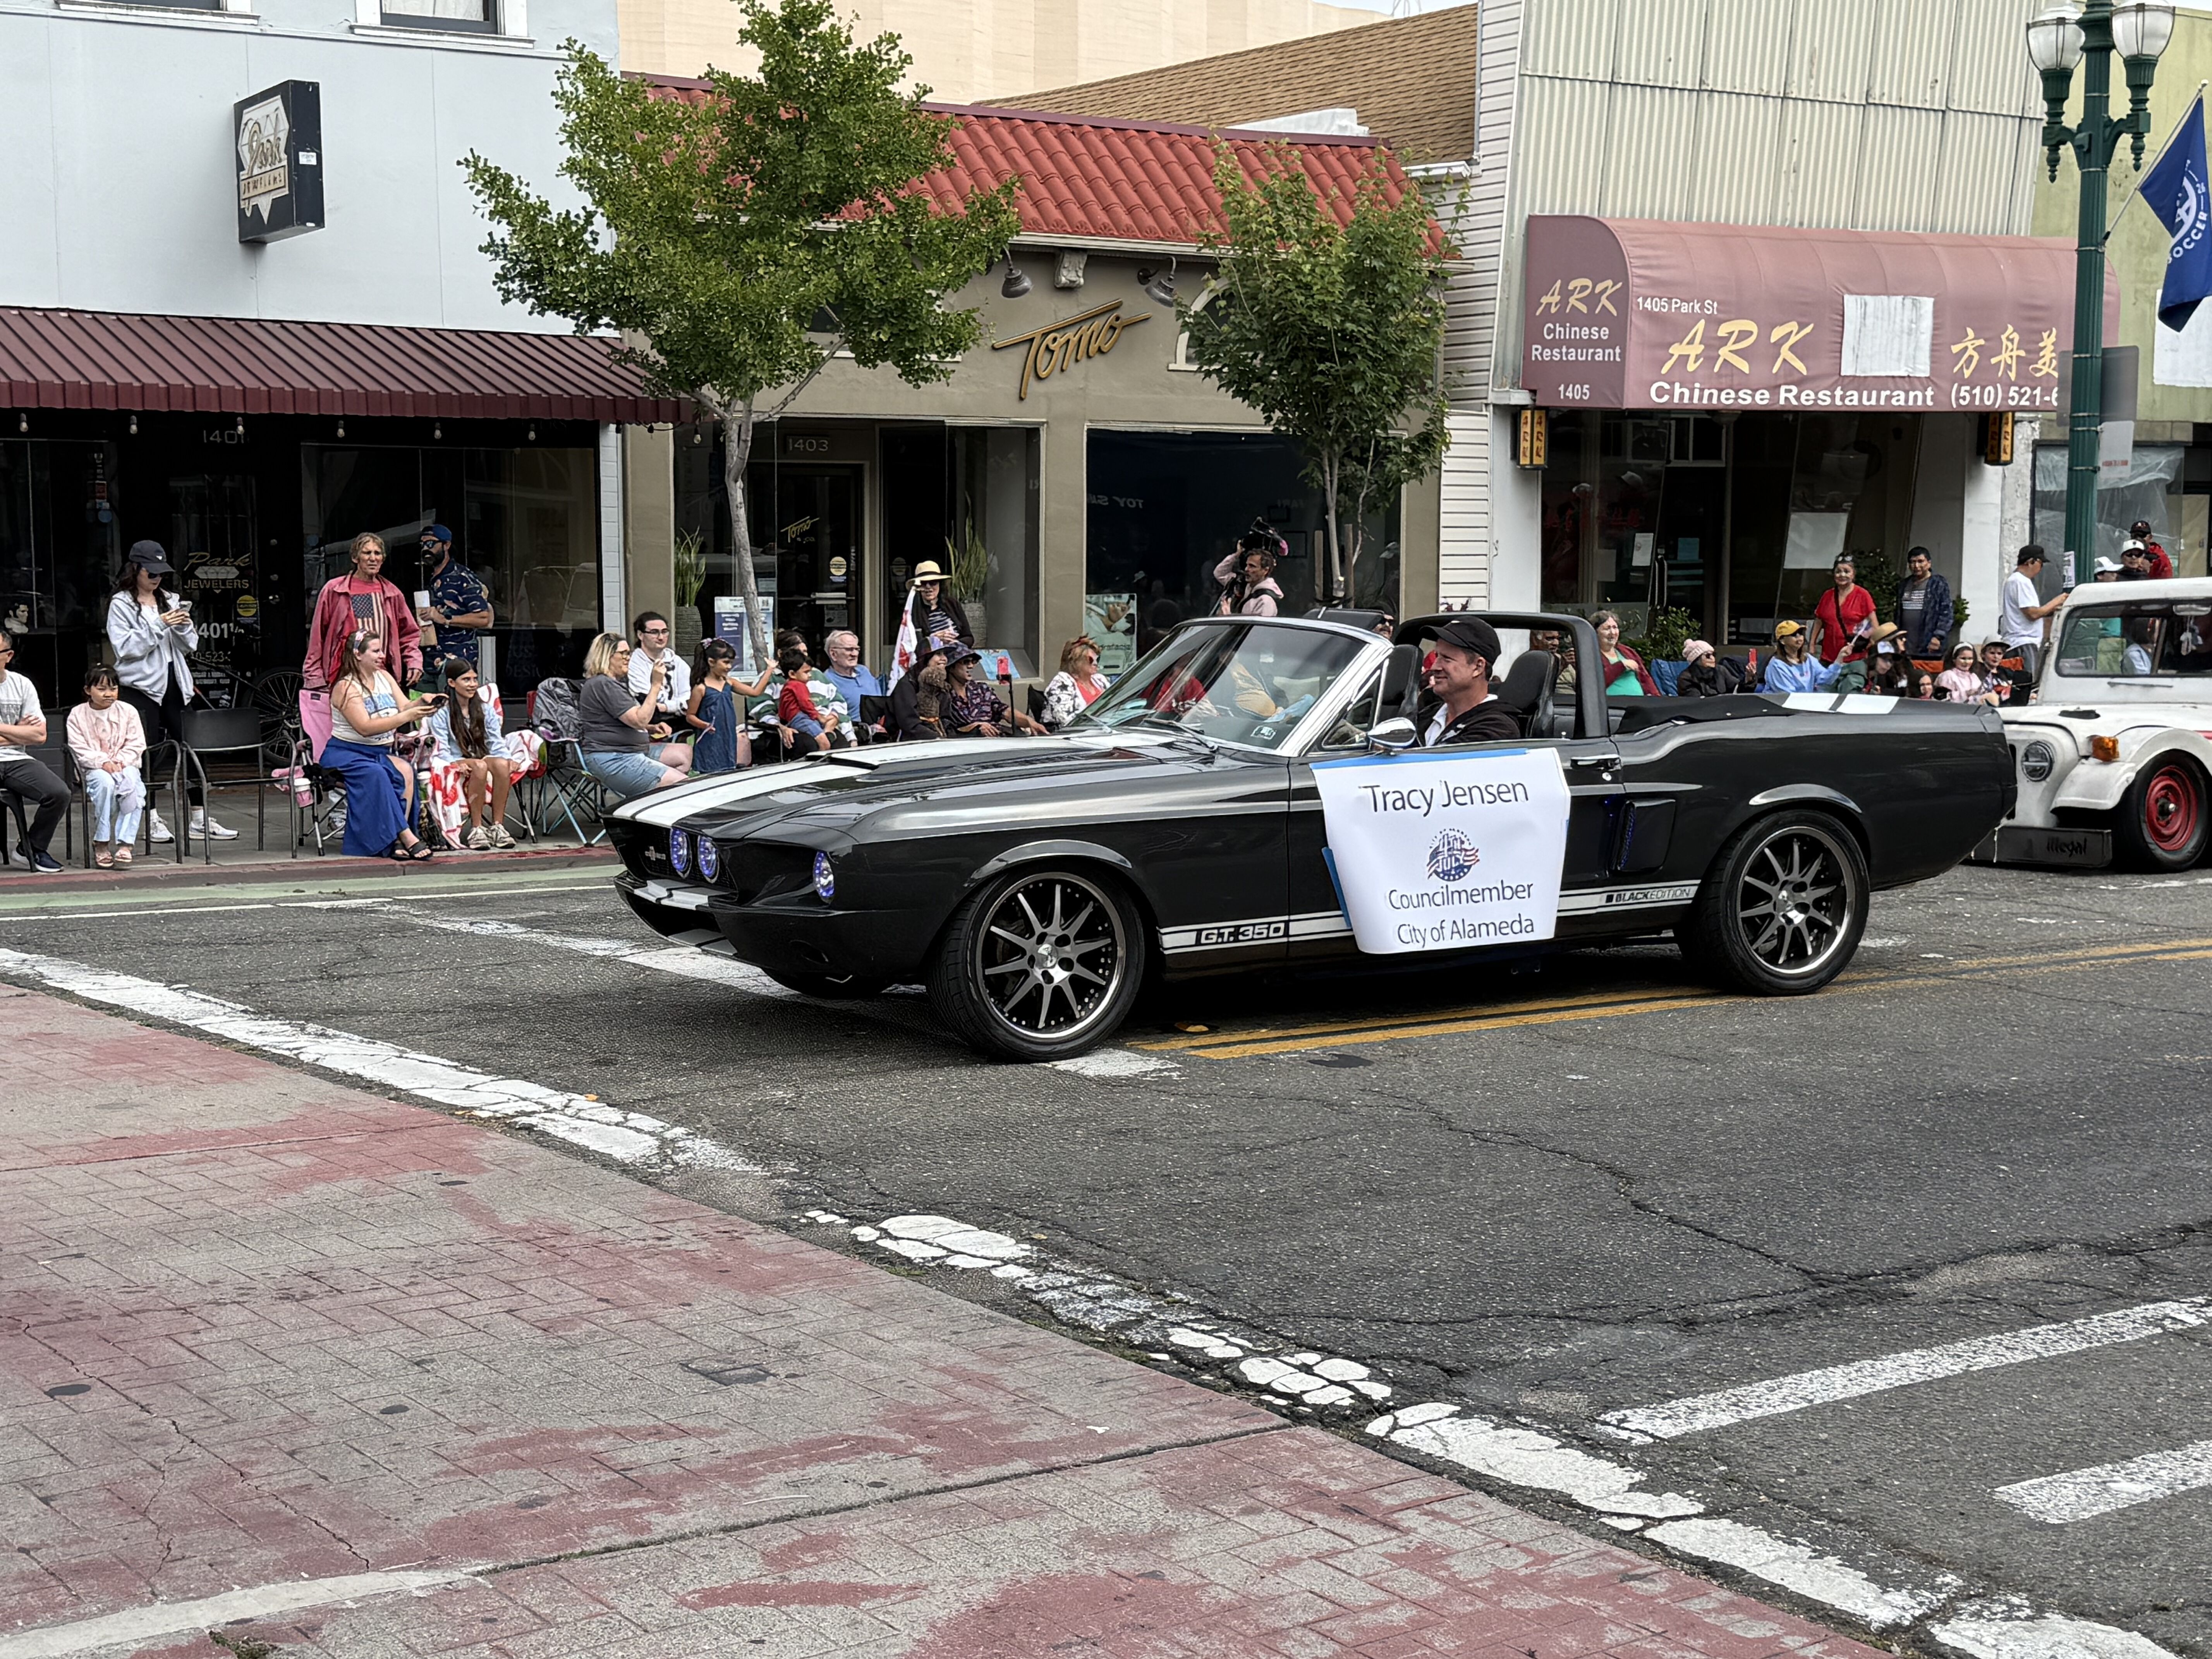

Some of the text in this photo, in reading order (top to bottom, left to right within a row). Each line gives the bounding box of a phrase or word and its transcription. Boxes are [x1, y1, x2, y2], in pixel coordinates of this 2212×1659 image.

[1536, 278, 1622, 316] ARK
[1637, 297, 1718, 315] 1405 Park St
[1543, 323, 1609, 340] Chinese
[992, 298, 1152, 400] Tomo
[1531, 344, 1621, 362] Restaurant
[1661, 319, 1814, 375] ARK
[1558, 384, 1590, 400] 1405
[1650, 381, 1770, 405] Chinese
[1779, 385, 1934, 406] Restaurant
[1951, 383, 2002, 409] (510)
[788, 438, 829, 452] 1403
[184, 552, 252, 571] Park
[184, 579, 250, 589] JEWELERS
[1358, 780, 1529, 817] Tracy Jensen
[1388, 879, 1534, 910] Councilmember
[1397, 914, 1535, 948] City of Alameda
